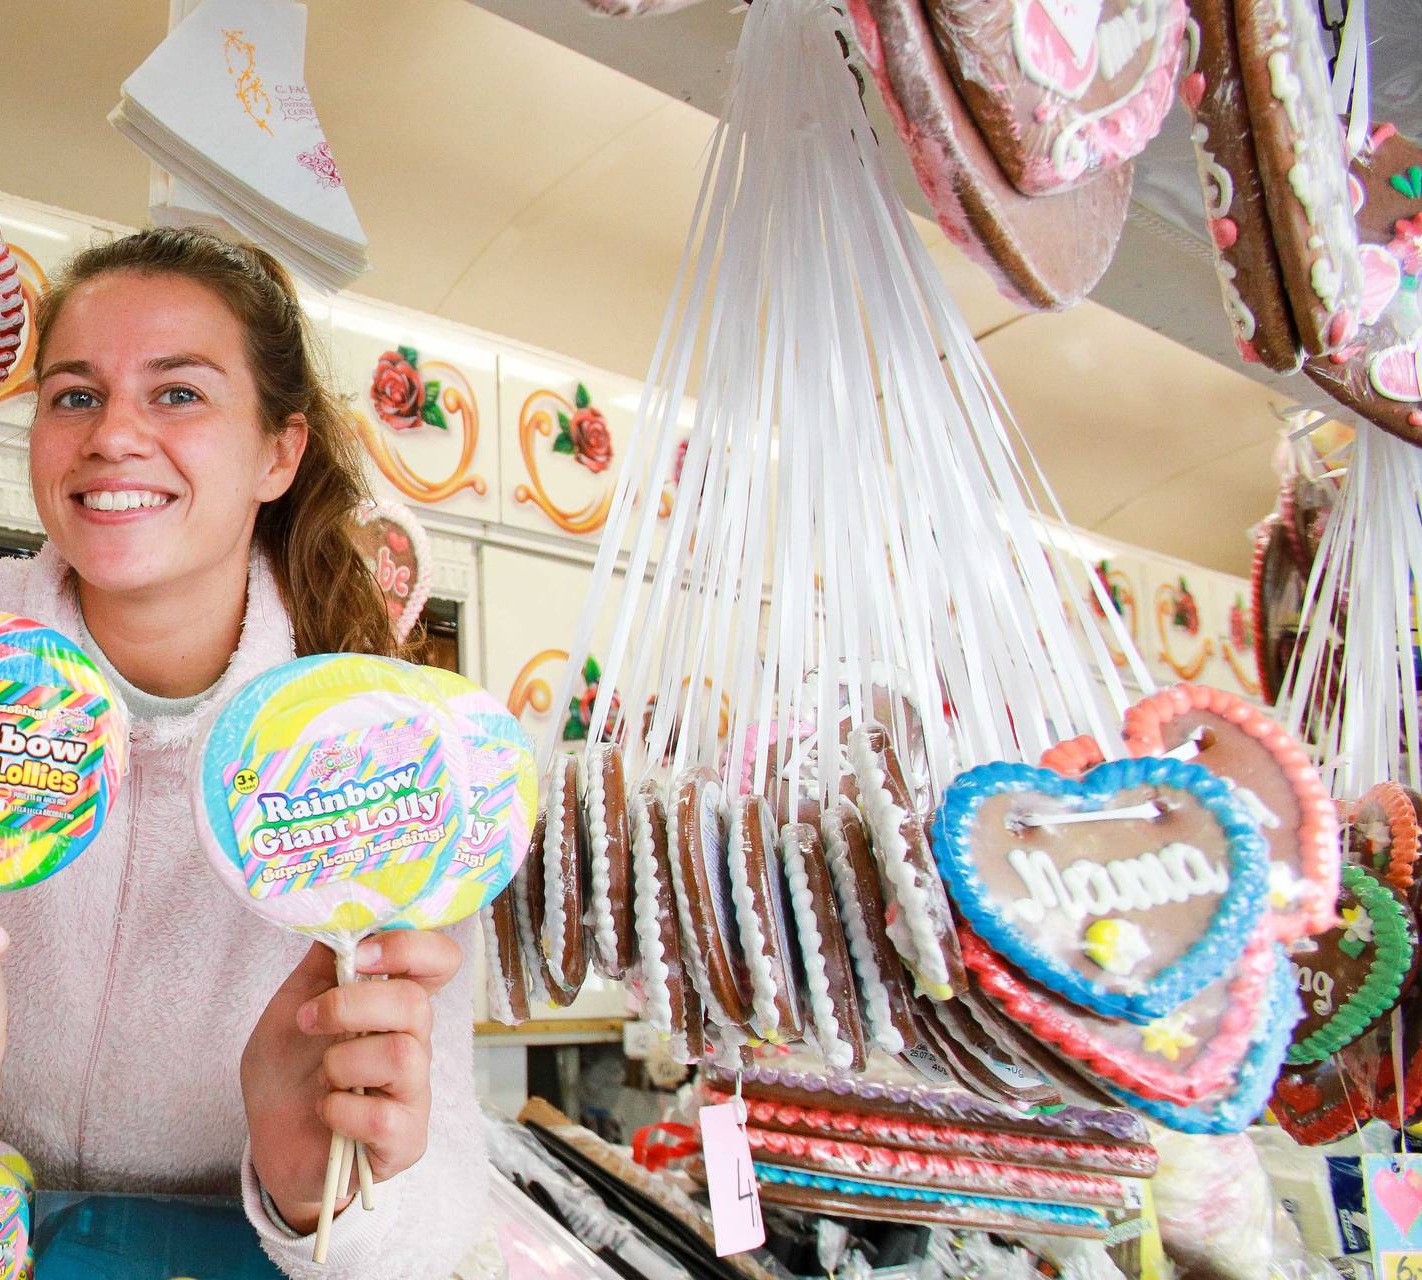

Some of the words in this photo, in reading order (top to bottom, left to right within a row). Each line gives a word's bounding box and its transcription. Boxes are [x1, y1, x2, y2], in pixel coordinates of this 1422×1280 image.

[237, 773, 256, 786] 3+
[261, 767, 417, 823] Rainbow
[252, 816, 351, 856] Giant
[356, 791, 441, 833] Lolly
[262, 859, 318, 883] Super
[320, 847, 365, 868] Long
[367, 824, 446, 856] Lasting!
